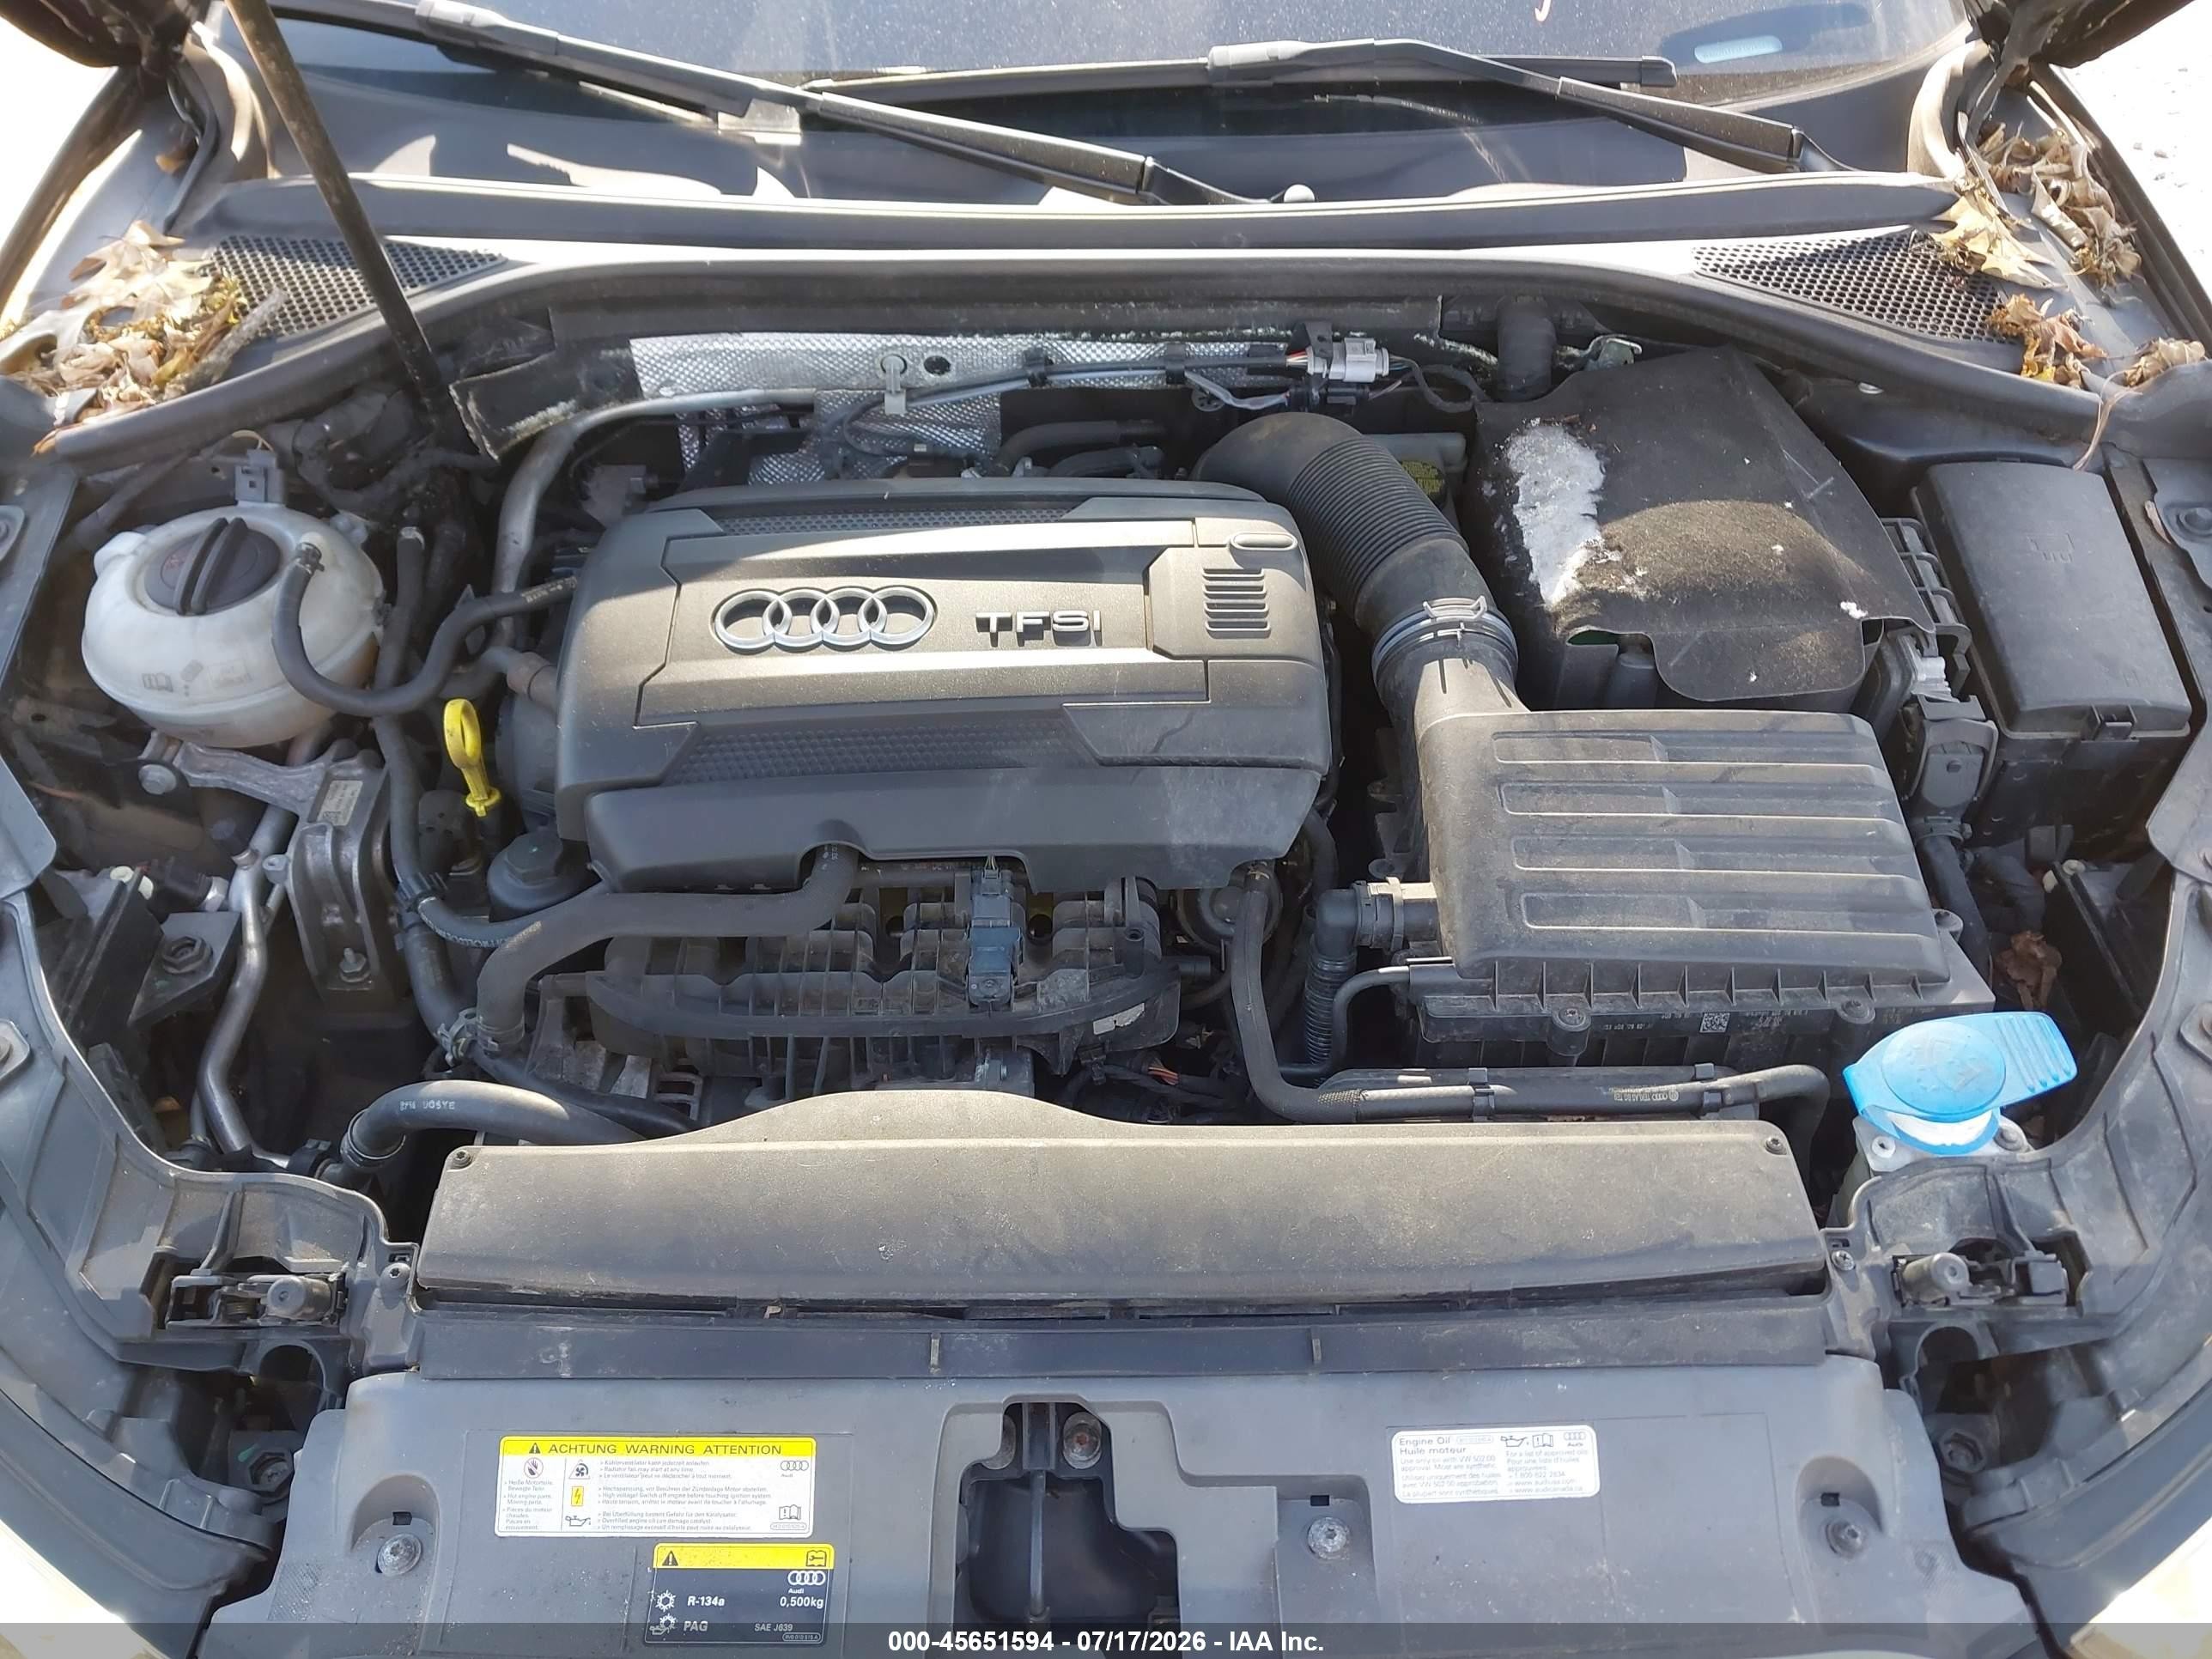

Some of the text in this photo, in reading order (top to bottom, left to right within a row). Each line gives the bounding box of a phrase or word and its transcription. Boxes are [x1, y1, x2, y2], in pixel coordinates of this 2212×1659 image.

[975, 611, 1102, 641] TFSI
[1399, 1437, 1434, 1447] Engine
[548, 1444, 782, 1455] ACHTUNG WARNING ATTENTION
[687, 1595, 824, 1609] R-134a 0,500kg
[684, 1620, 708, 1632] PAG
[773, 1623, 793, 1632] J639
